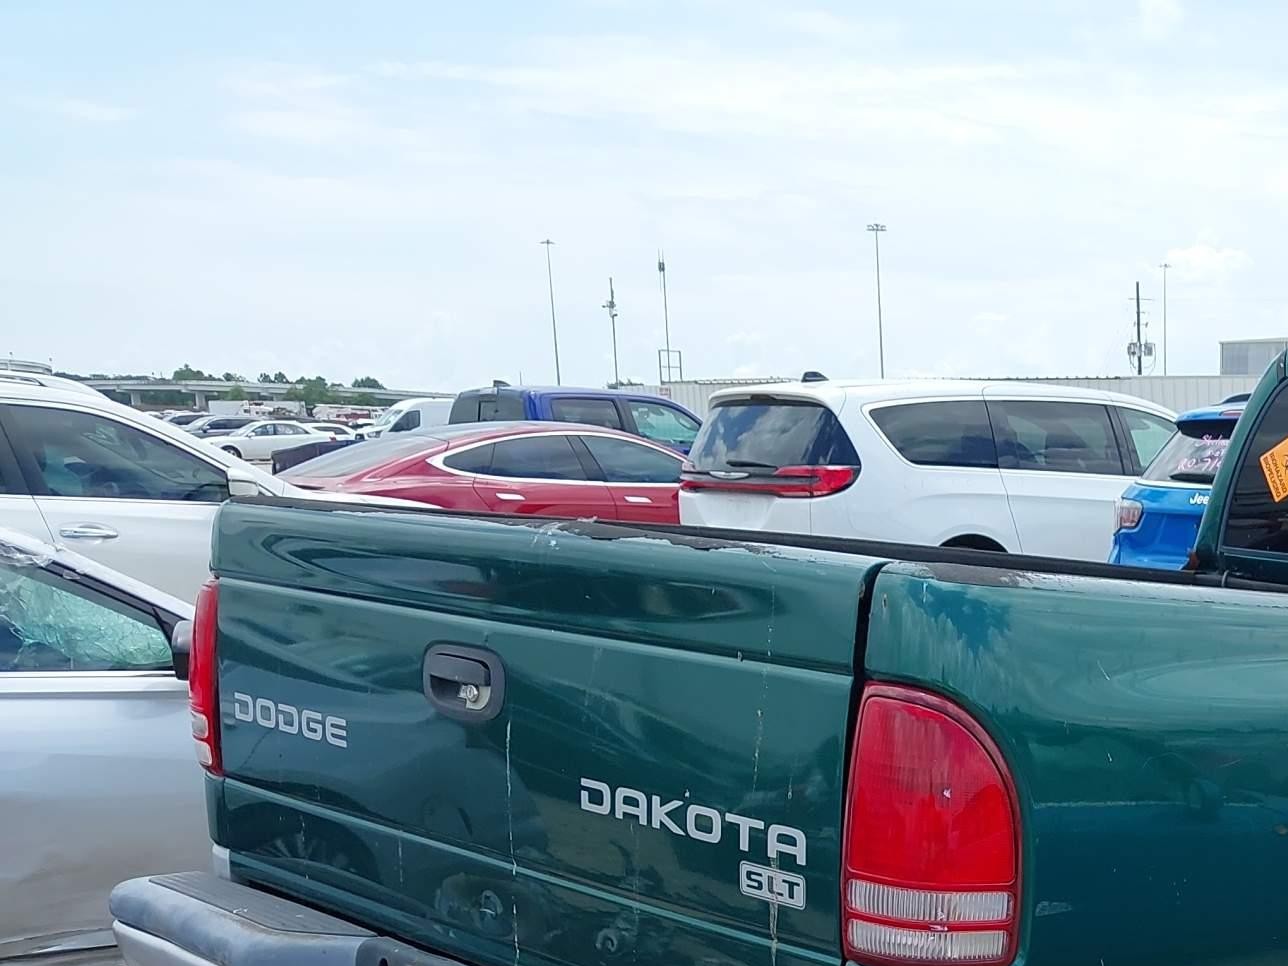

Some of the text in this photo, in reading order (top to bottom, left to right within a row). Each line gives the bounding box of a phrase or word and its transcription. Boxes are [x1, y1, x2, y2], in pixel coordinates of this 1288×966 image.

[1270, 451, 1287, 494] BIOHAZARD
[1190, 493, 1210, 505] Jee
[234, 692, 348, 748] DODGE
[580, 777, 807, 866] DAKOTA
[745, 871, 800, 900] SLT
